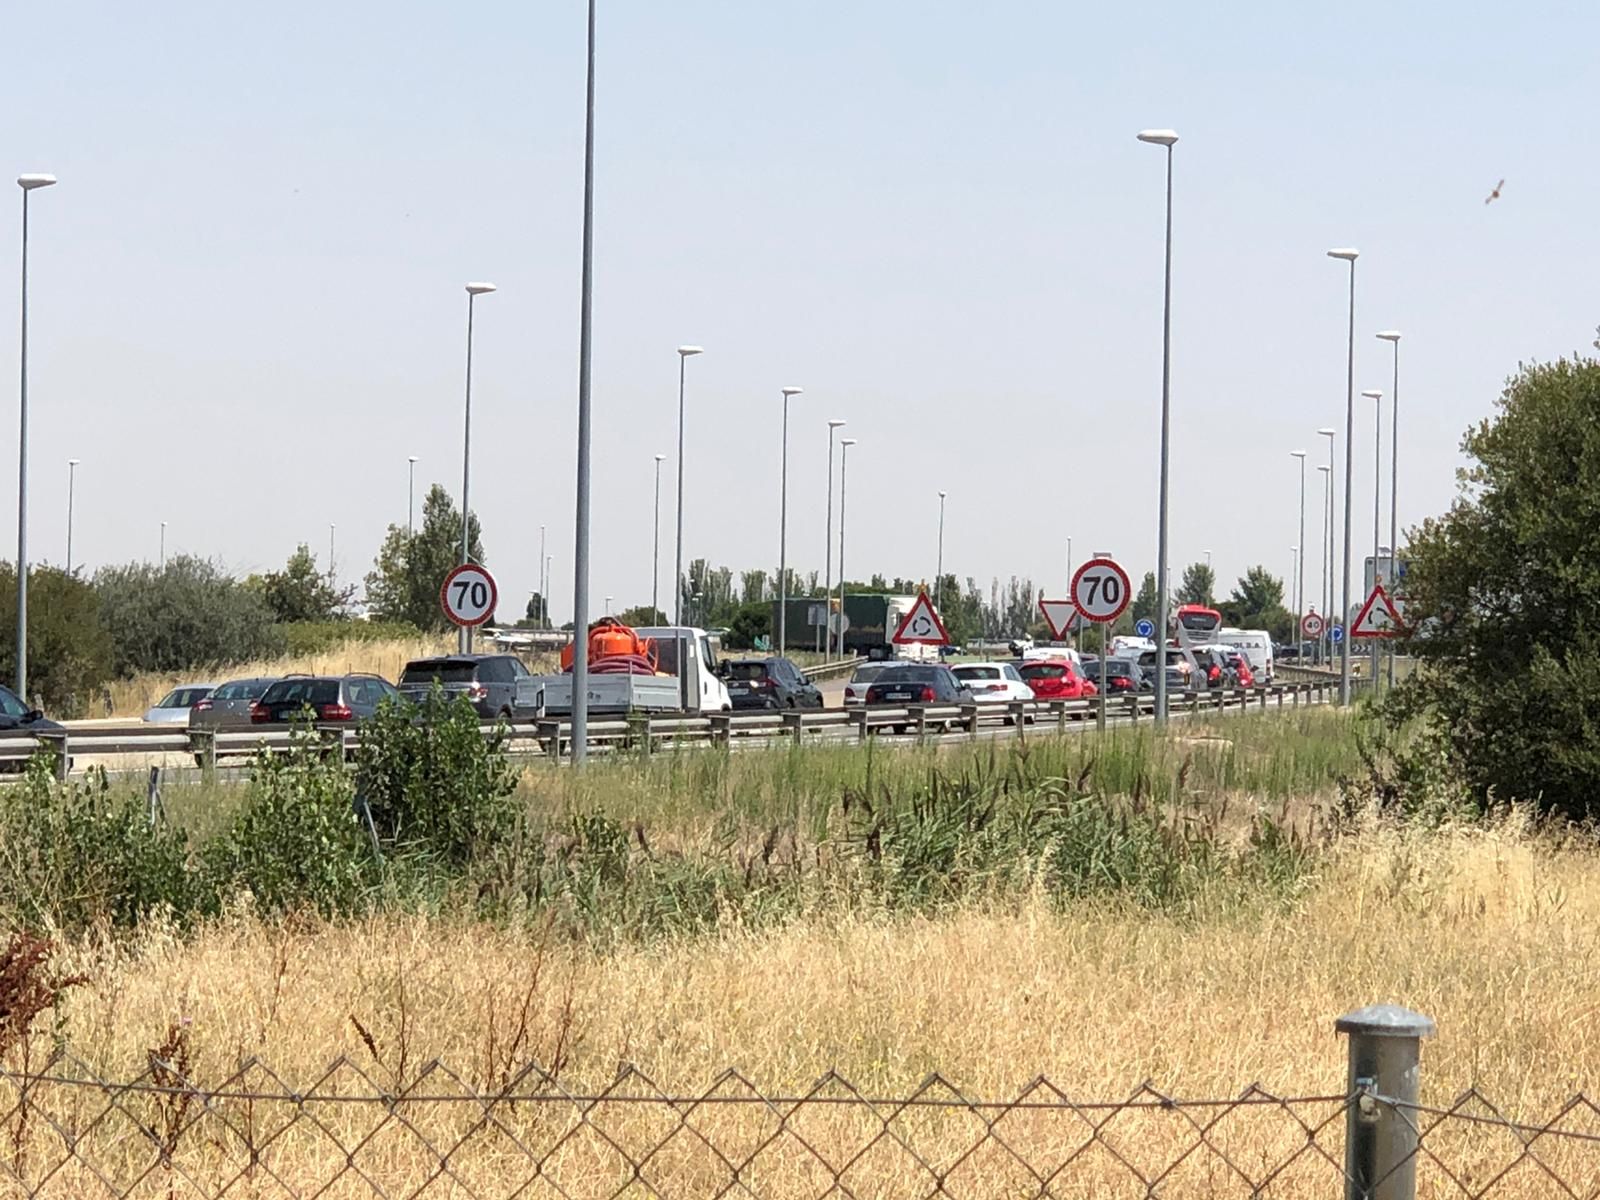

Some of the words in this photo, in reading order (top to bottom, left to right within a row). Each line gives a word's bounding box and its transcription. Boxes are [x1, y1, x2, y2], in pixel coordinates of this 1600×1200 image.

[453, 581, 487, 610] 70
[1083, 576, 1119, 606] 70
[1307, 621, 1320, 629] 40
